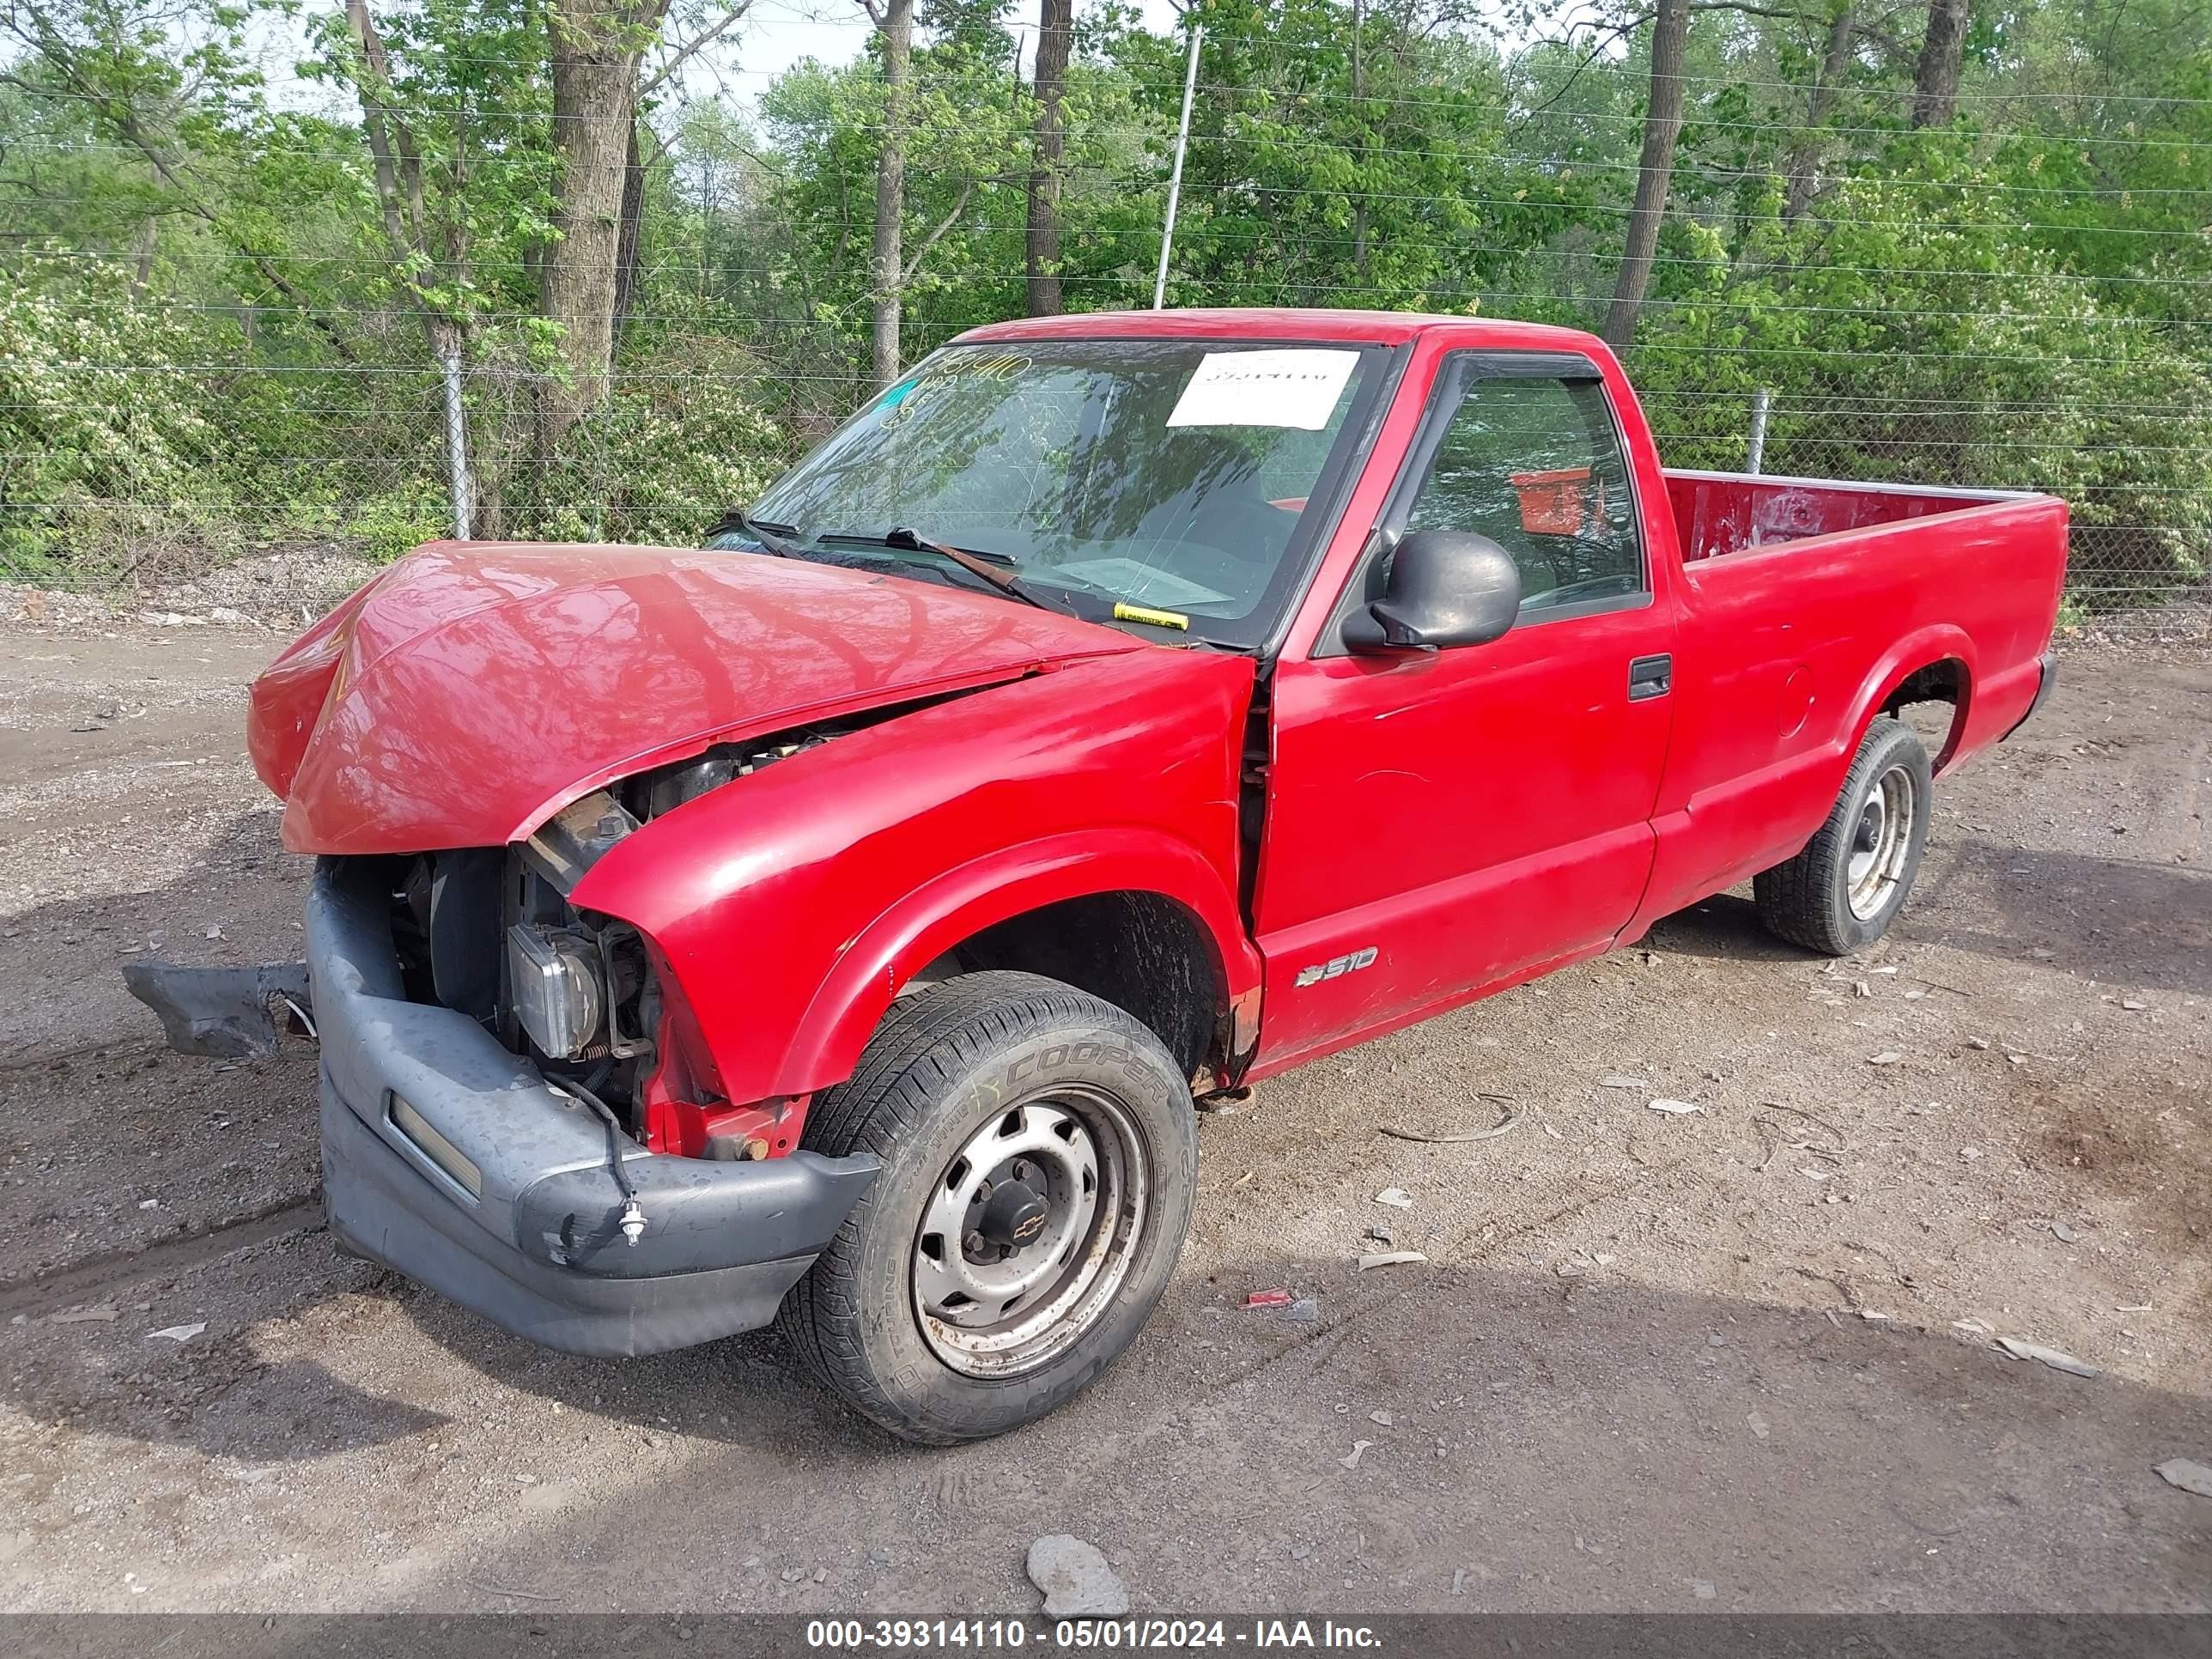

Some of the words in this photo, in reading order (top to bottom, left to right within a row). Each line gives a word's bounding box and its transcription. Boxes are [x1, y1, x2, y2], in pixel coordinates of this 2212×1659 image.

[1323, 945, 1379, 981] S10
[1006, 1042, 1170, 1104] COOPER
[884, 1257, 905, 1360] TOURING
[893, 1364, 1011, 1425] GRAND
